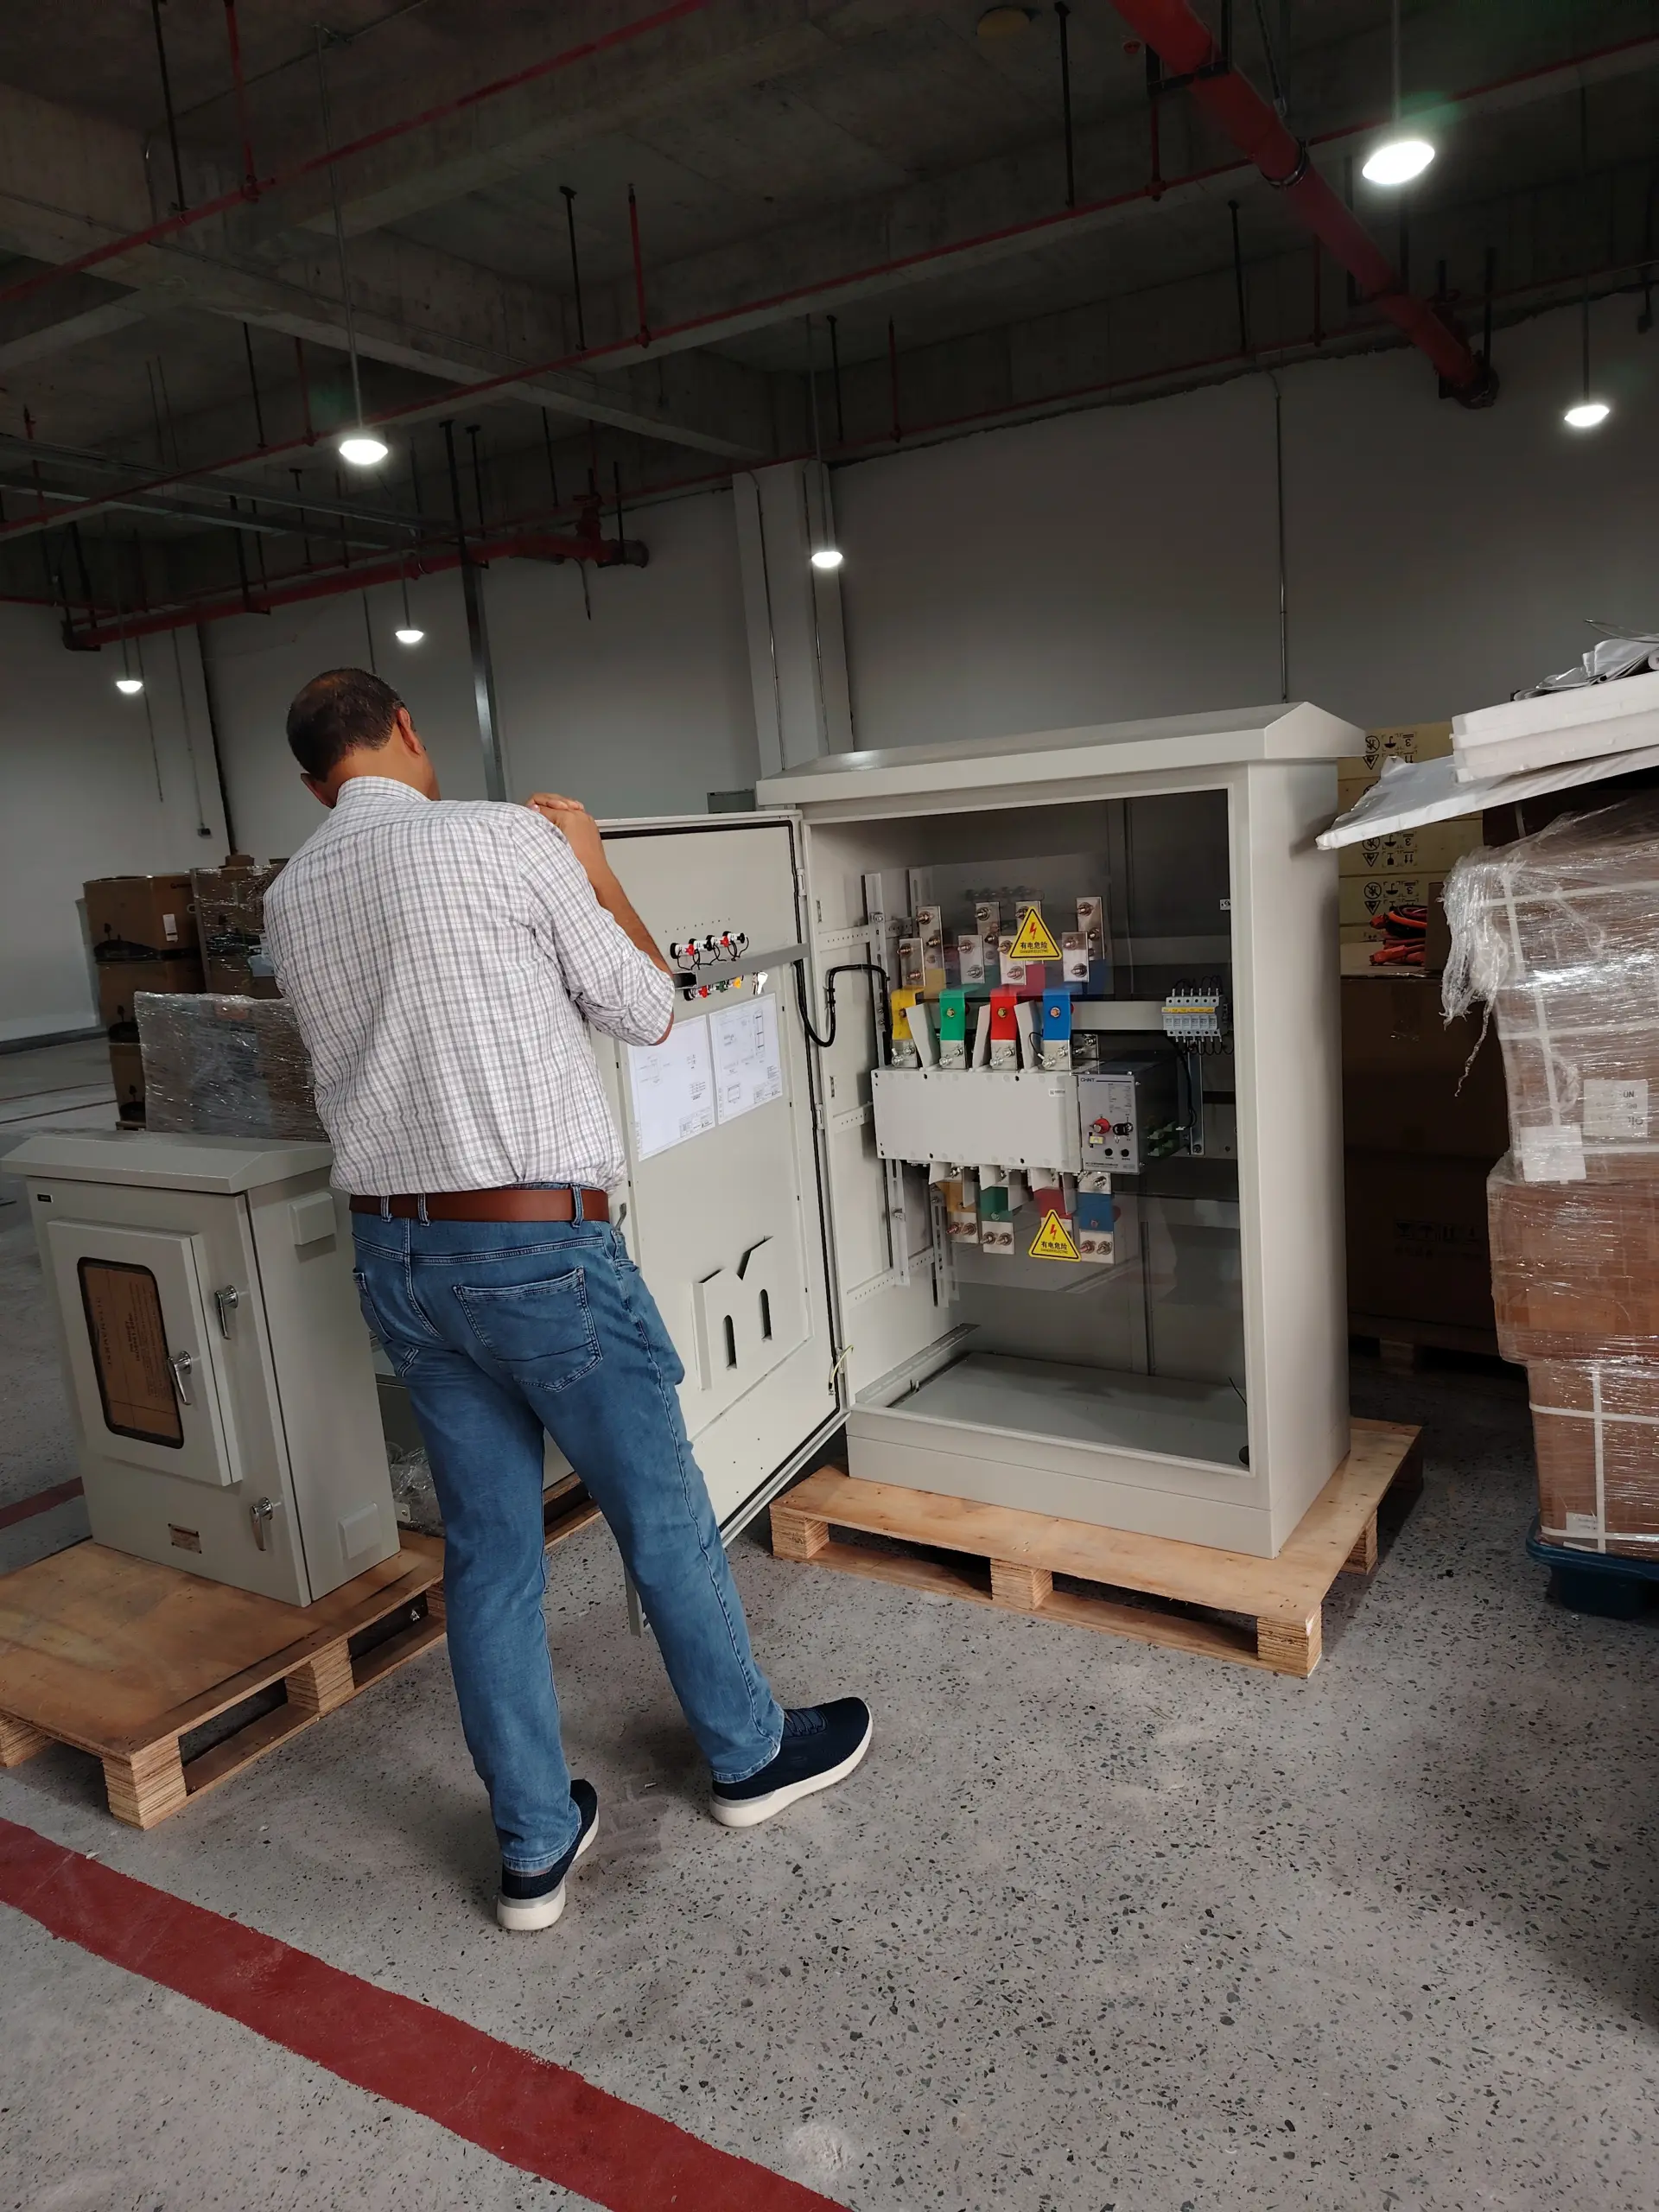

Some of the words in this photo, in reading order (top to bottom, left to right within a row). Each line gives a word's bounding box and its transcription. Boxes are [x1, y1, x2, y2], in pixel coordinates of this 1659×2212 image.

[1020, 941, 1048, 950] 有电危险
[1040, 1241, 1068, 1250] 有电危险
